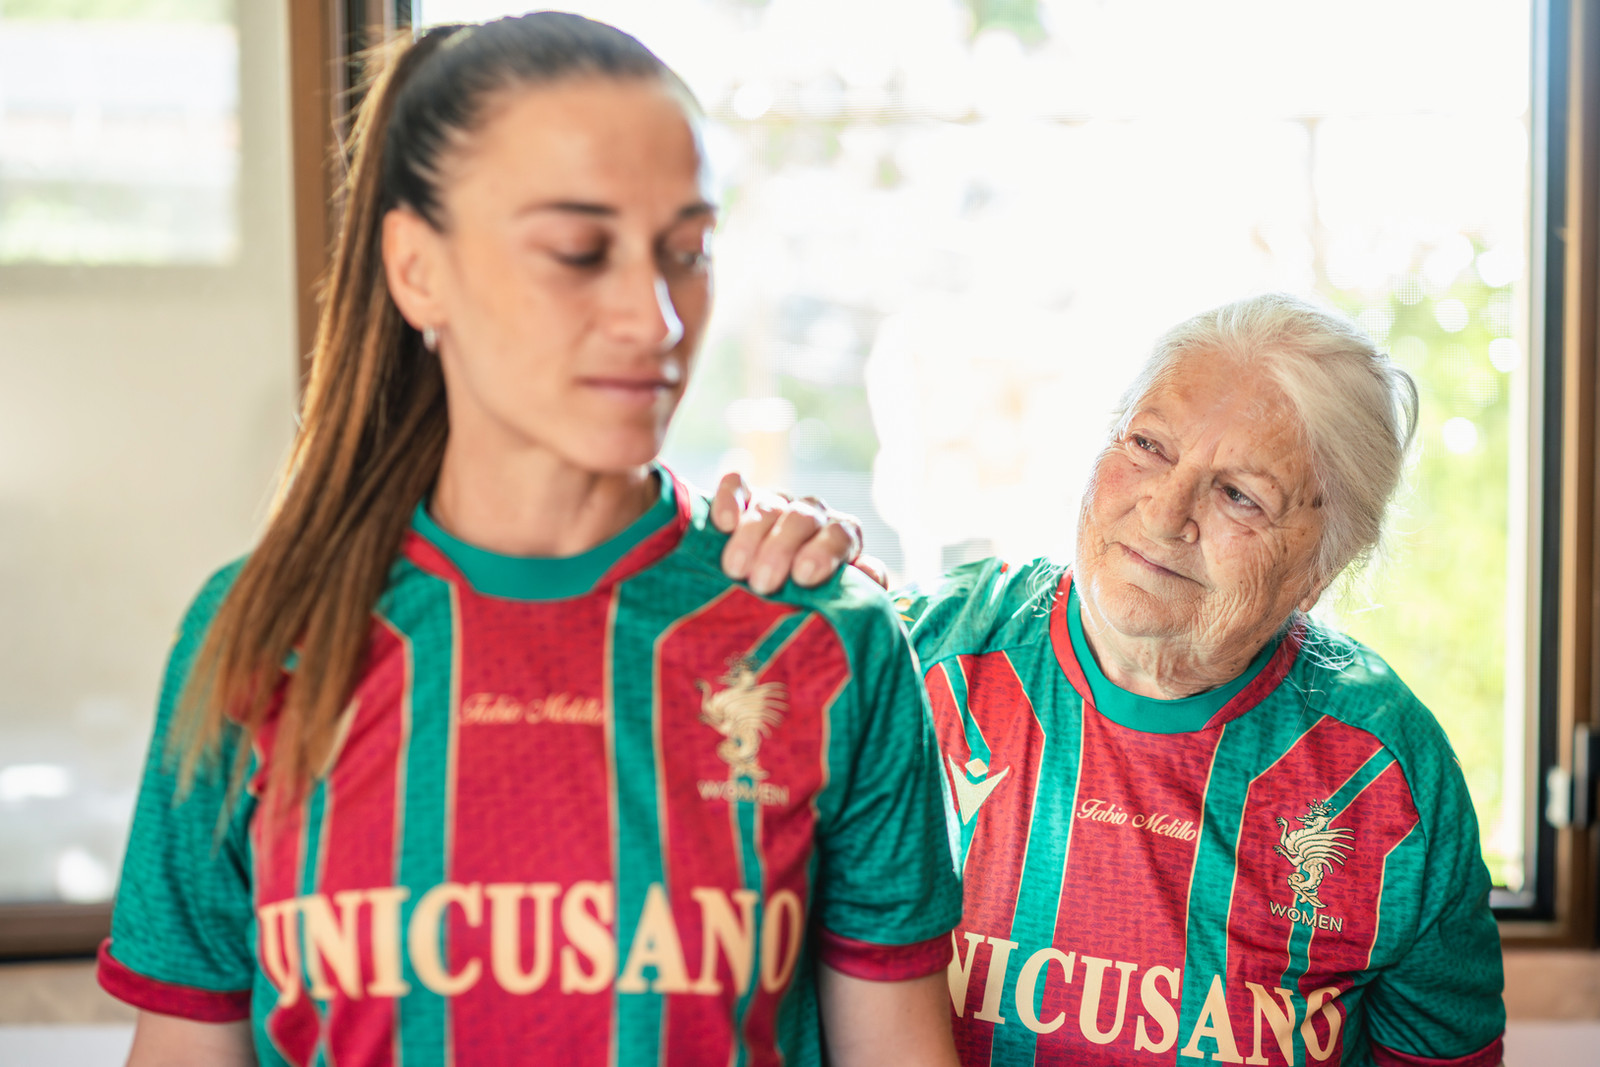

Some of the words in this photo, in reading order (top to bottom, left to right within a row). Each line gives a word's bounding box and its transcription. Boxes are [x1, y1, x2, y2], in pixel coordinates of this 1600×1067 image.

[697, 780, 789, 806] WOMEN
[1076, 798, 1128, 825] Fabio
[1132, 812, 1197, 841] Melillo
[1270, 901, 1343, 932] WOMEN
[258, 881, 801, 1007] UNICUSANO
[947, 930, 1341, 1067] NICUSANO
